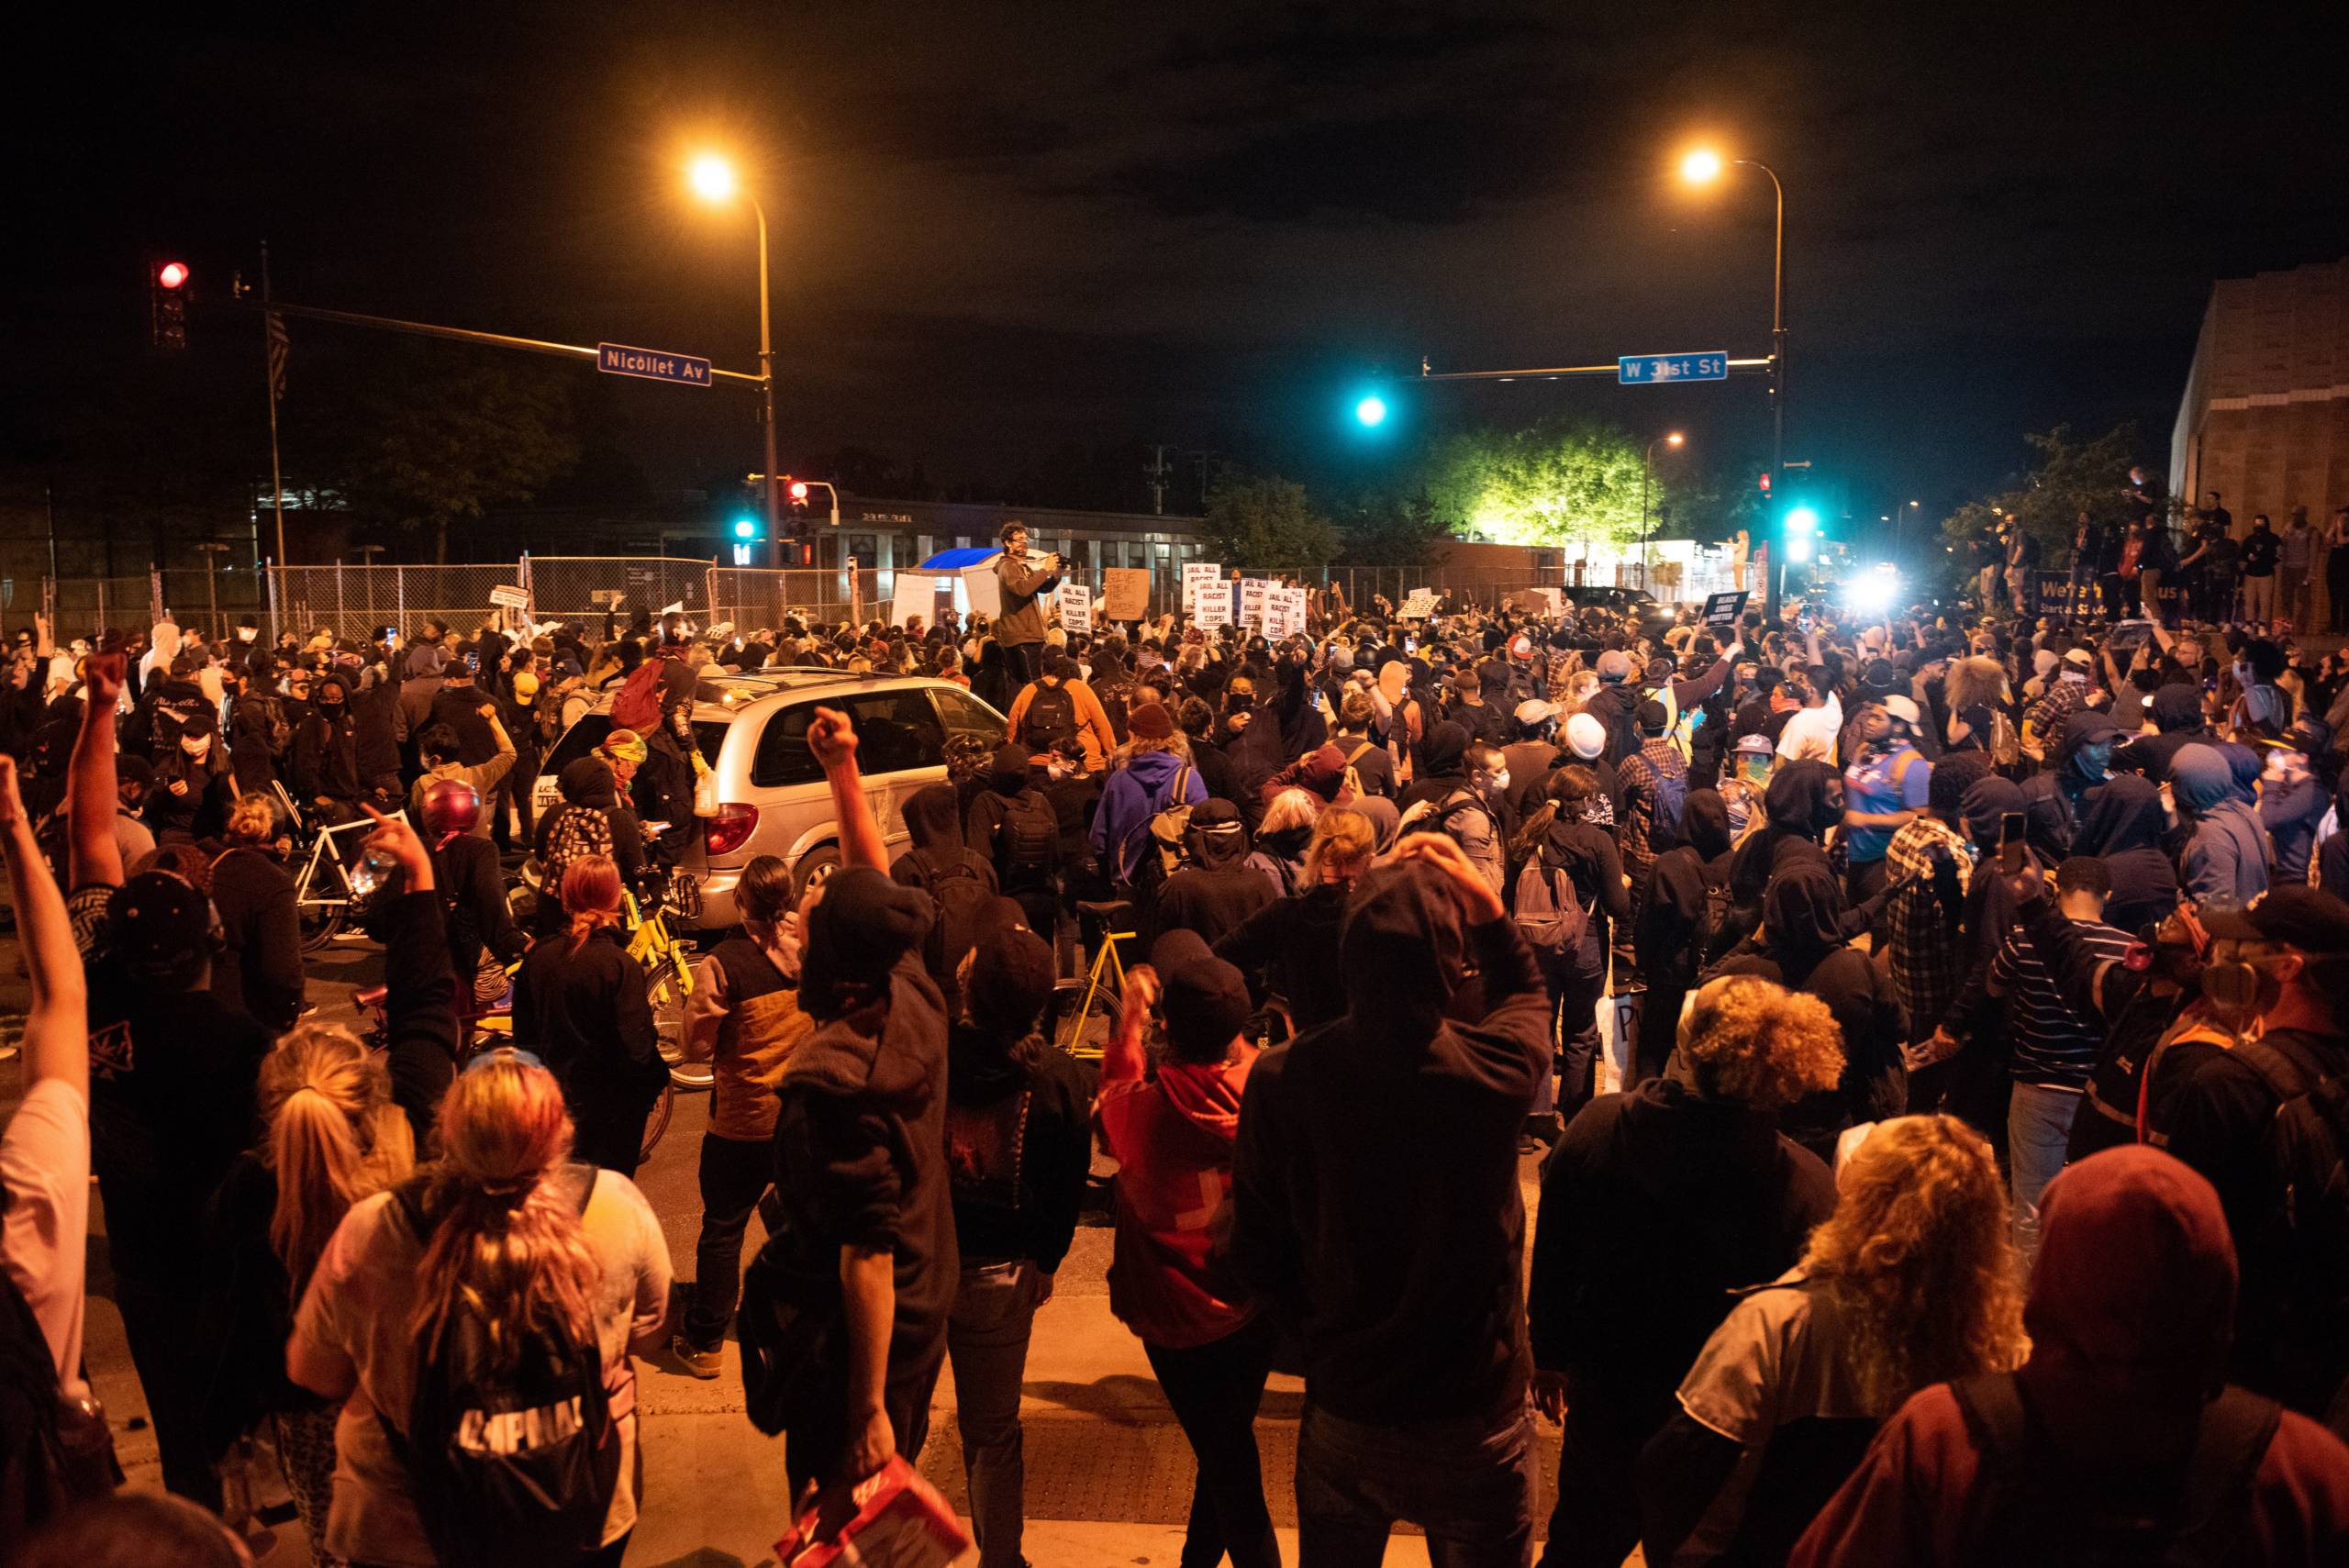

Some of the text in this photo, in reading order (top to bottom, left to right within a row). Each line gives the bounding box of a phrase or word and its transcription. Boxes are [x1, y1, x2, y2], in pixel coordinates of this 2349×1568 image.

[607, 350, 704, 379] Nicollet Av
[1626, 362, 1641, 377] W
[1698, 359, 1720, 374] St
[1064, 597, 1084, 606] RACIST
[1065, 609, 1085, 617] KILLER
[1271, 605, 1290, 613] RACIST
